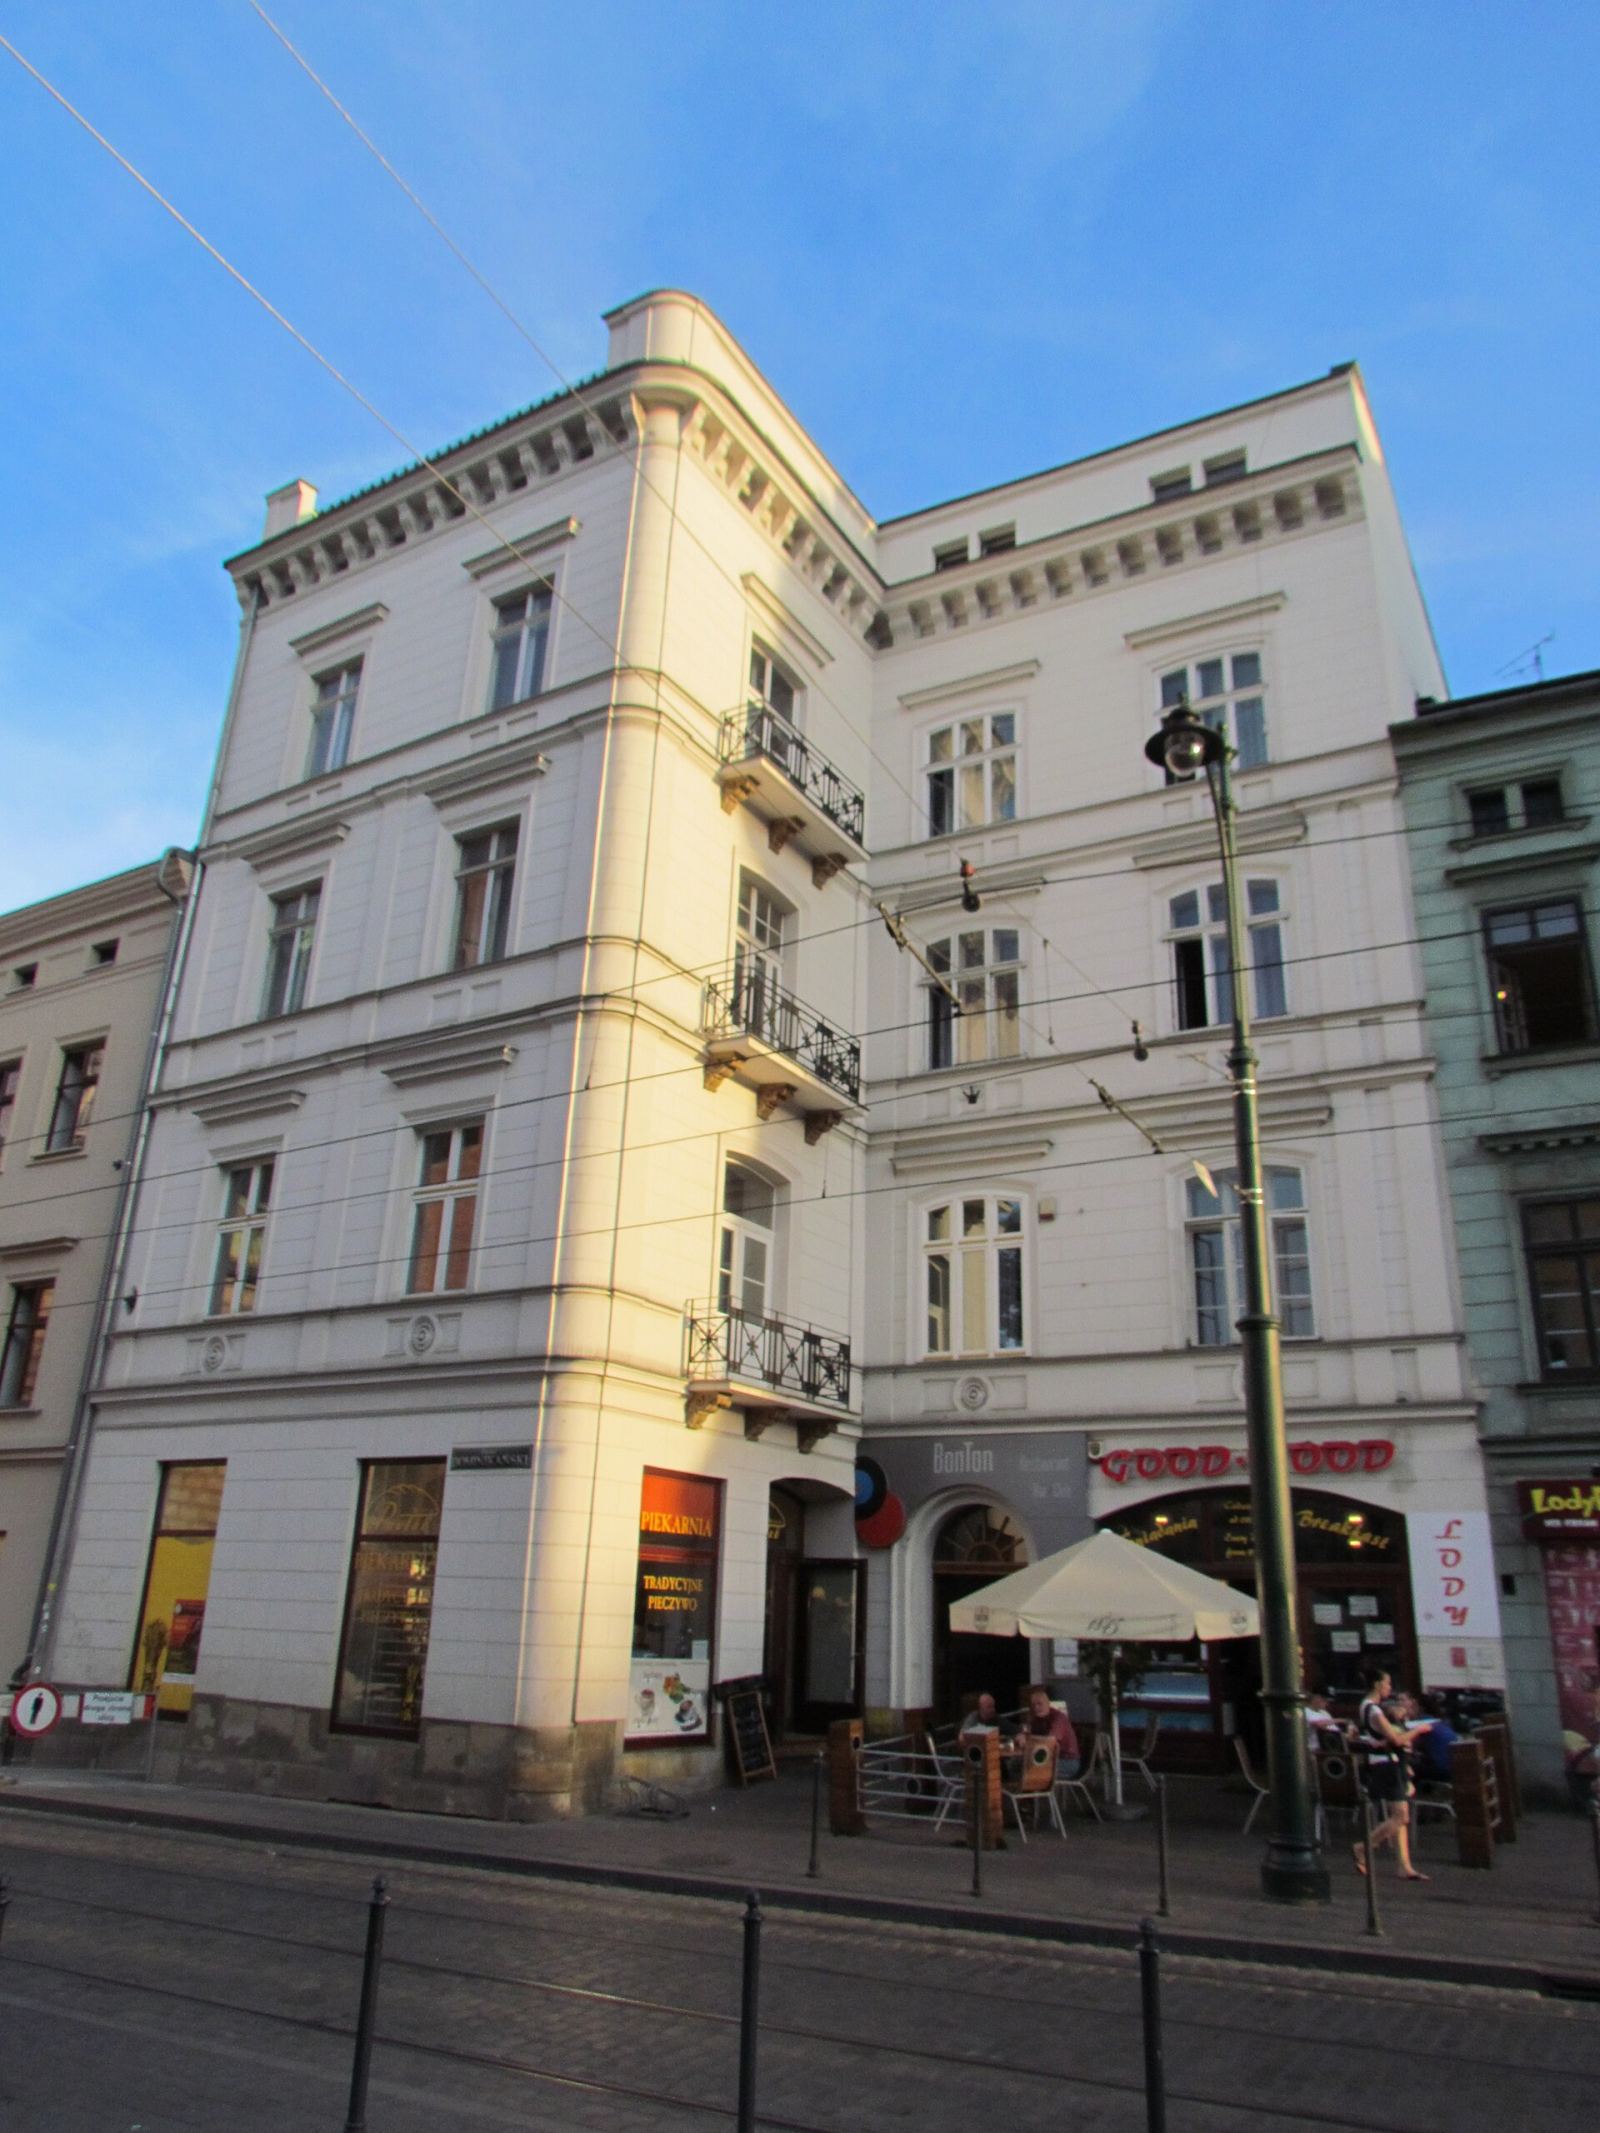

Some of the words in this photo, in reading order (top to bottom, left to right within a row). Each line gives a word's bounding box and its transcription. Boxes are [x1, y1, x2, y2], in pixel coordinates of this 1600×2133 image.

[933, 1441, 994, 1474] BonTon
[1101, 1446, 1231, 1483] GOOD
[1286, 1439, 1395, 1474] OOD
[641, 1511, 712, 1537] PIEKARNIA
[1297, 1509, 1390, 1549] Breakfast
[643, 1575, 704, 1594] TRADYCYJNE
[1434, 1519, 1469, 1626] LODY
[648, 1595, 698, 1611] PIECZYWO
